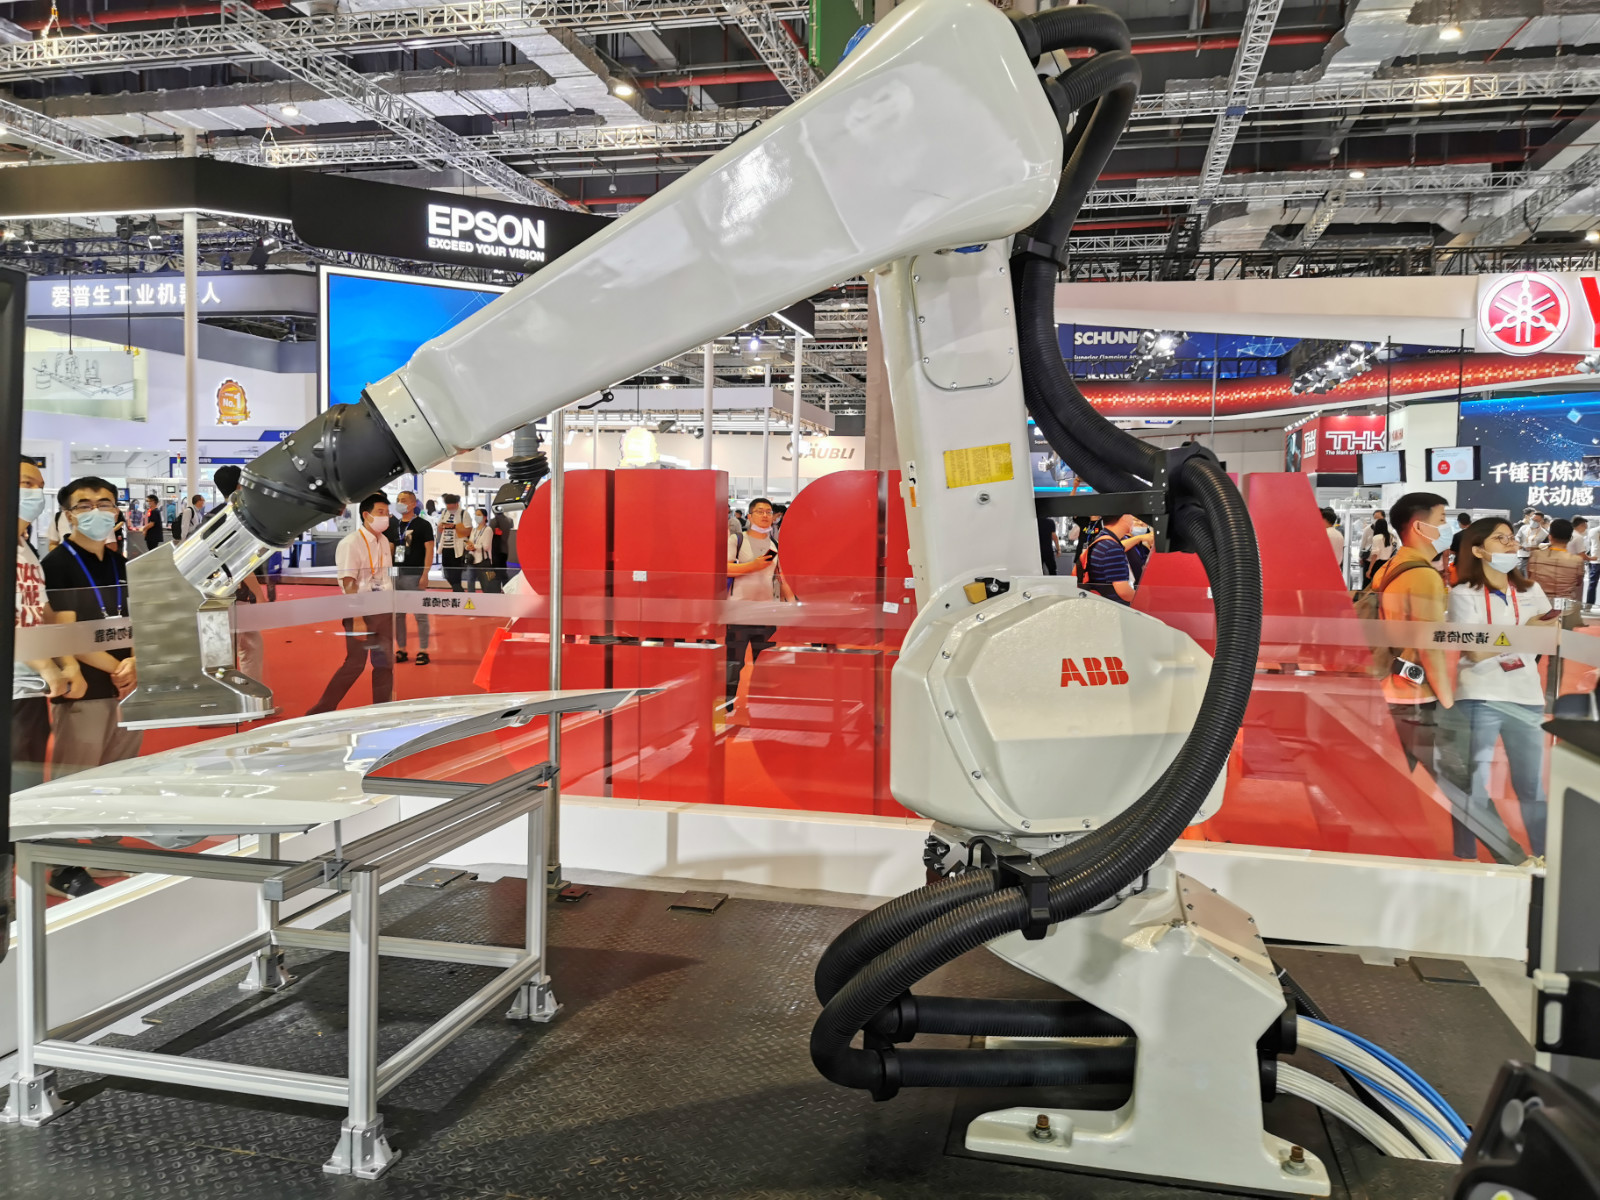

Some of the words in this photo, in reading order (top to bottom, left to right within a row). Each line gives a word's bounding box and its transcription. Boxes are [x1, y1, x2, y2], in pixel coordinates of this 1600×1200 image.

[428, 204, 545, 249] EPSON
[428, 237, 474, 253] EXCEED
[476, 243, 507, 257] YOUR
[508, 247, 545, 262] VISION
[1527, 485, 1594, 507] 跃动感
[1060, 656, 1129, 687] ABB
